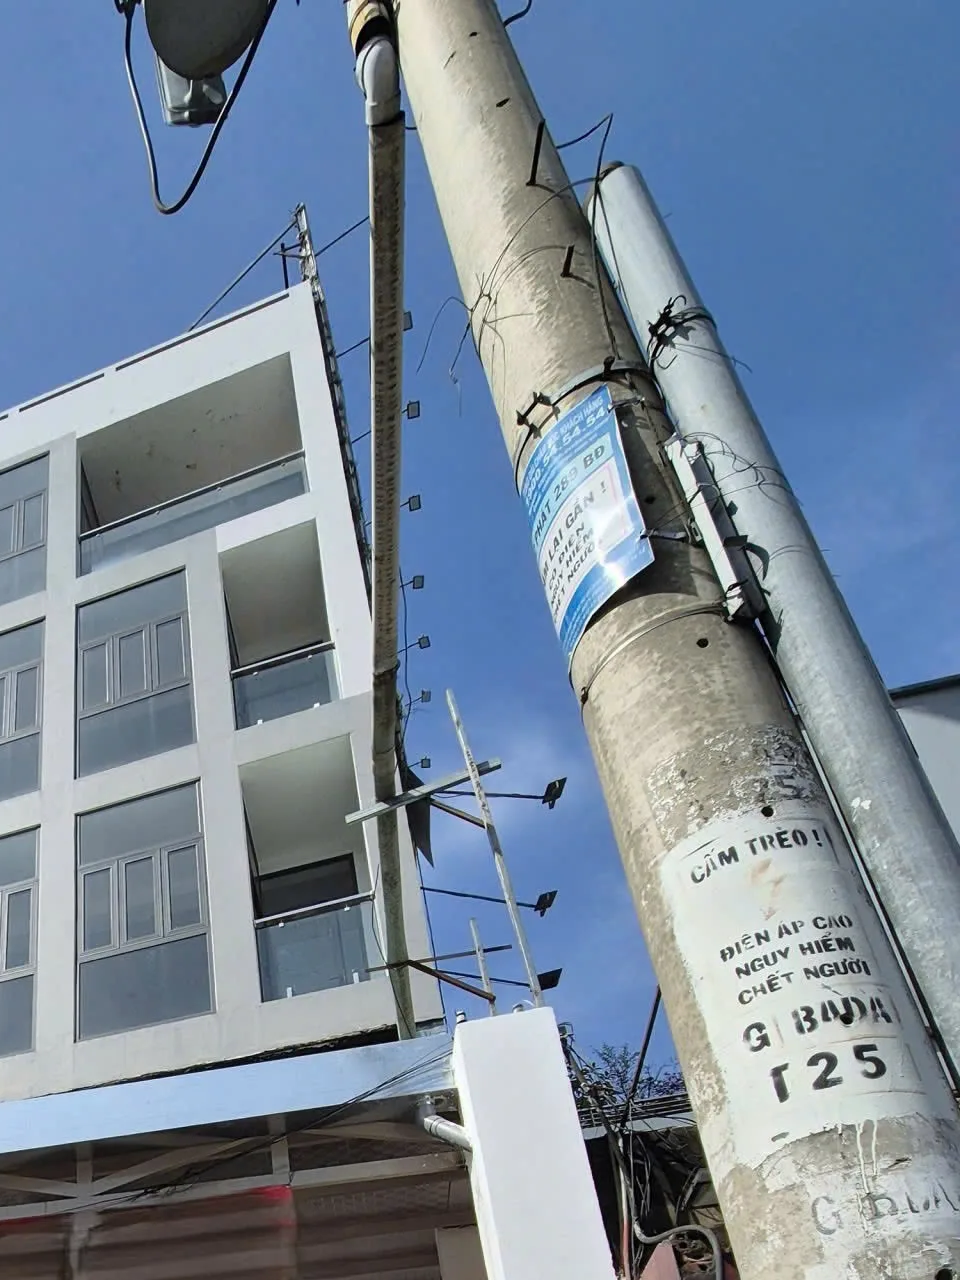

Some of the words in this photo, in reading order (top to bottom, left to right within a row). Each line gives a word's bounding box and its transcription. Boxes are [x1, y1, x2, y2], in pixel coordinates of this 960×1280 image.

[812, 915, 853, 930] CAO
[734, 946, 791, 980] NGUY
[798, 931, 856, 956] HIỂM
[737, 969, 795, 1005] CHẾT
[742, 1021, 772, 1053] G
